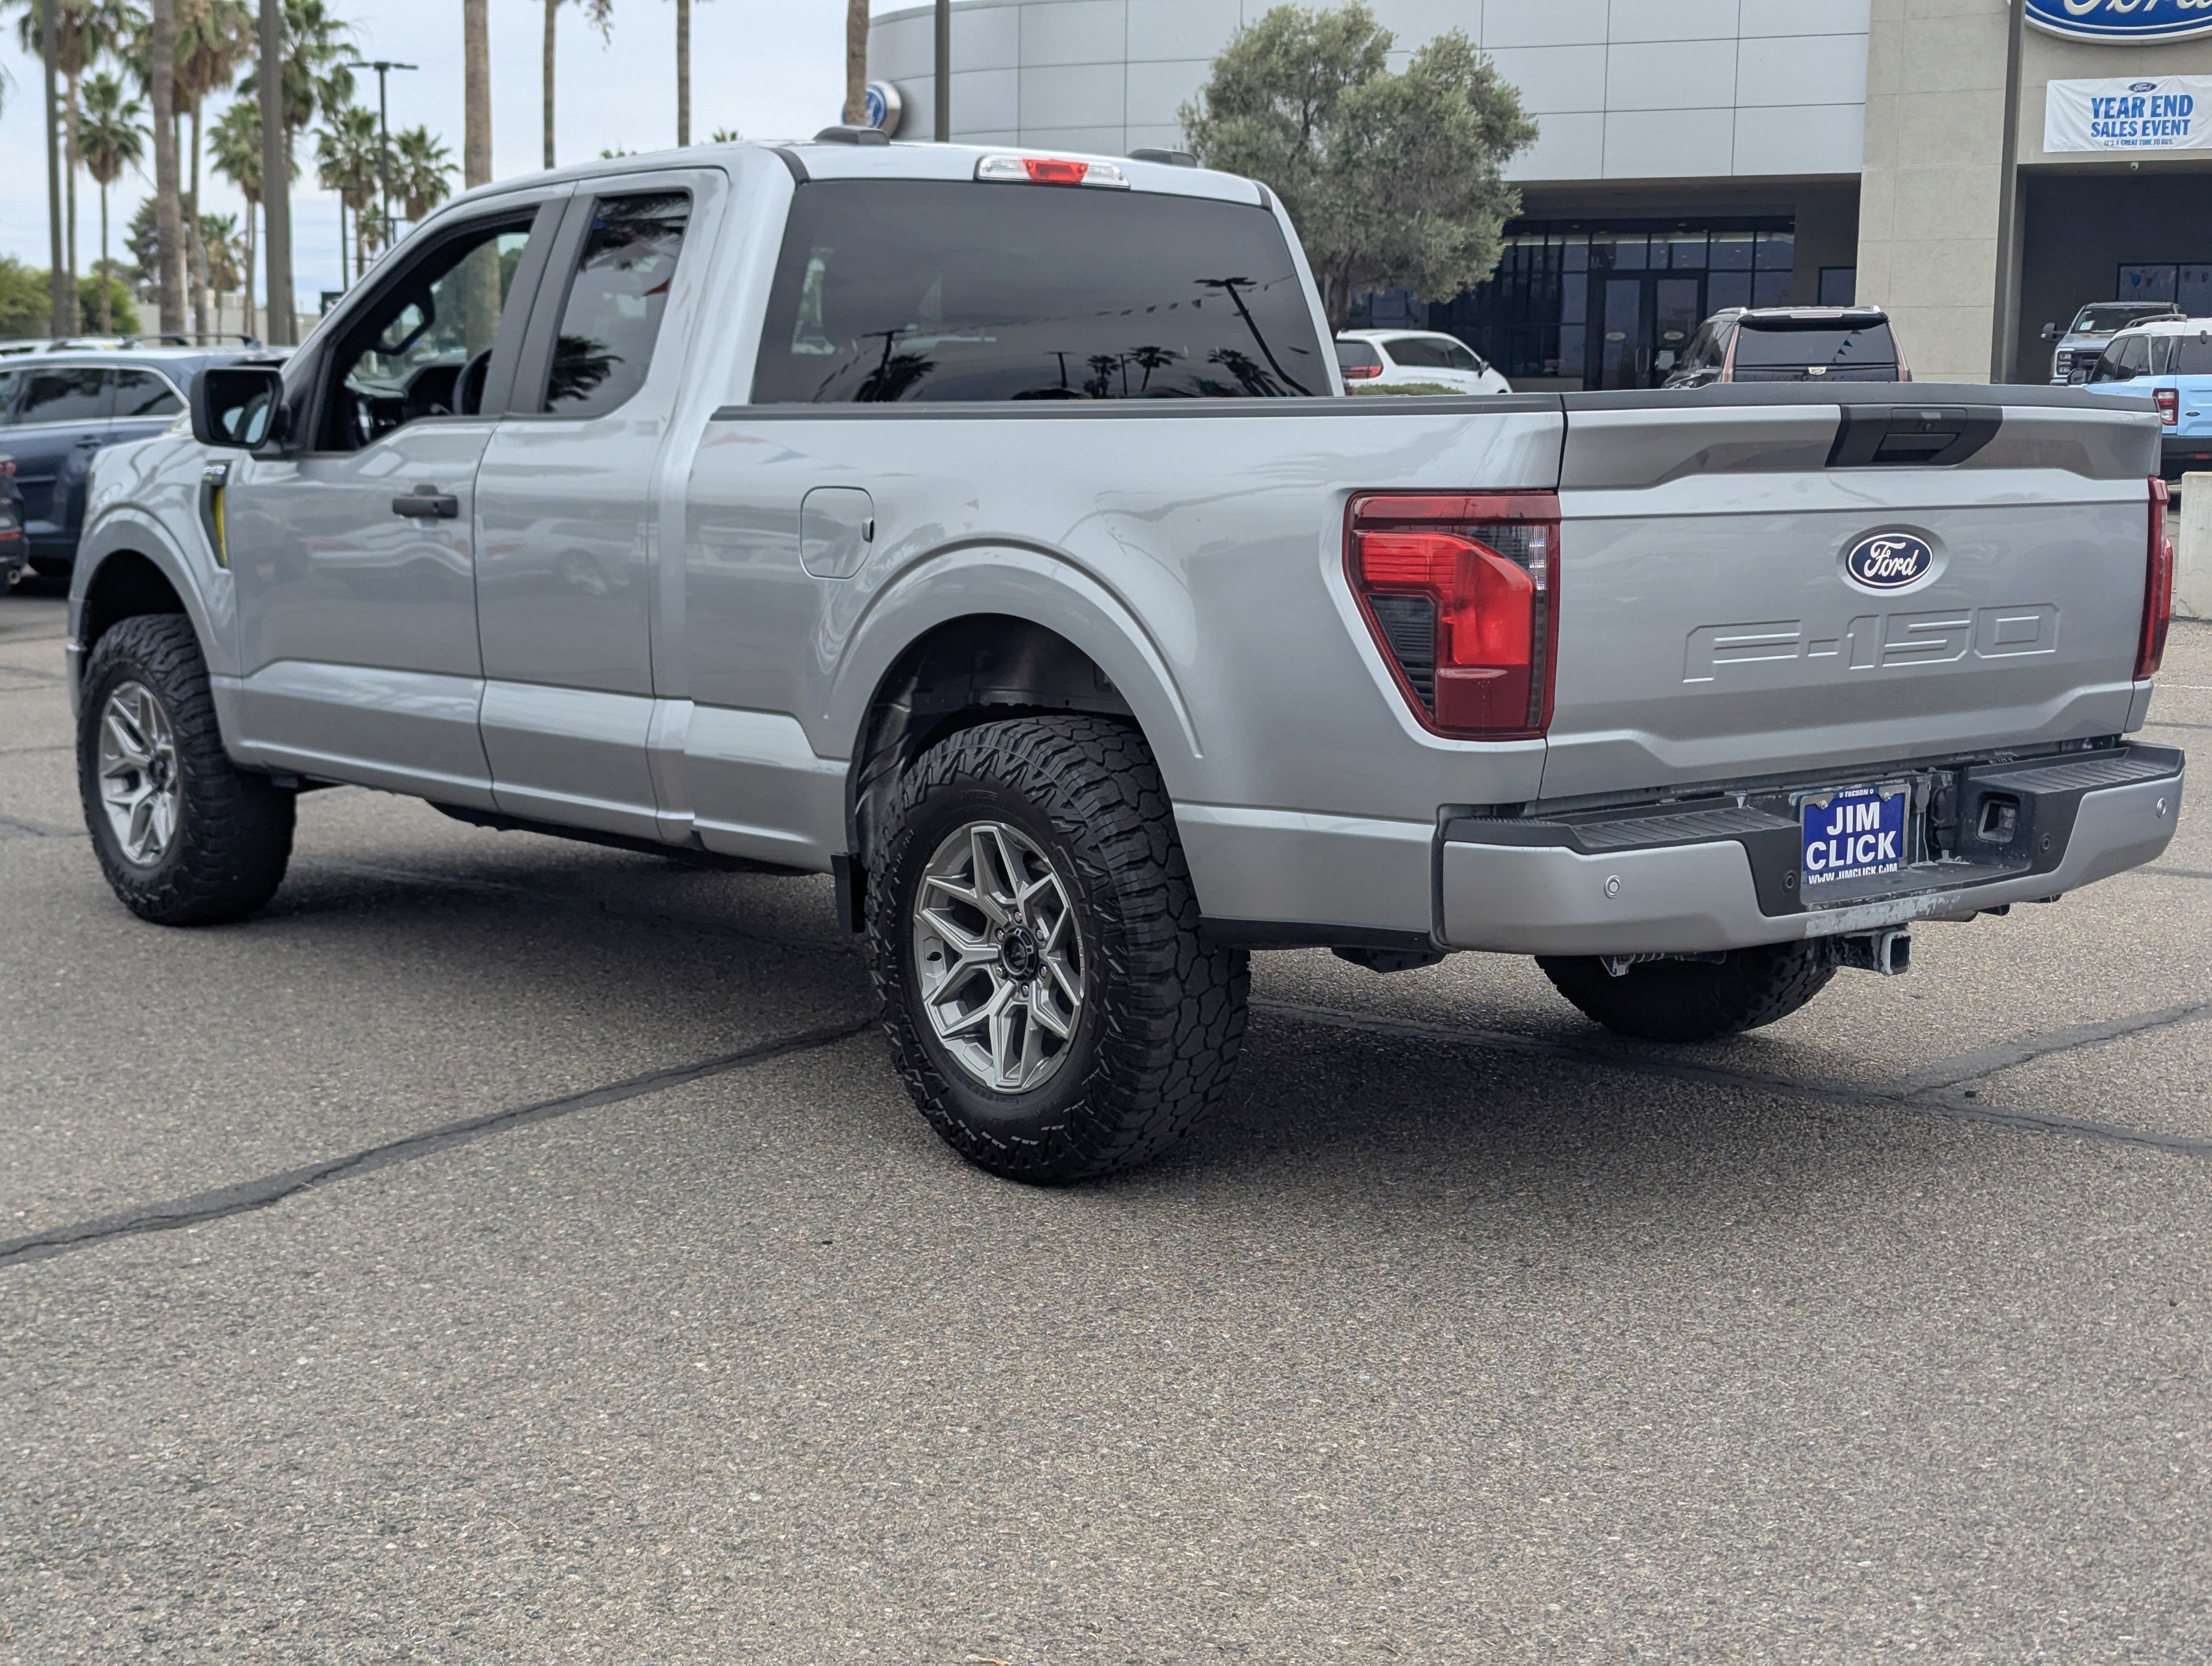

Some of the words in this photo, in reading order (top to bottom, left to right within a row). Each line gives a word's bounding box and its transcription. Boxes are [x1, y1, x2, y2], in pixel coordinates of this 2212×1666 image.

[2091, 96, 2146, 119] YEAR
[2150, 94, 2194, 118] END
[2091, 120, 2138, 138] SALES
[2142, 119, 2191, 137] EVENT
[1863, 540, 1918, 578] Ford
[1682, 603, 2060, 683] F-150
[1844, 789, 1869, 798] TUCSON
[1827, 801, 1880, 836] JIM
[1806, 830, 1897, 870] CLICK
